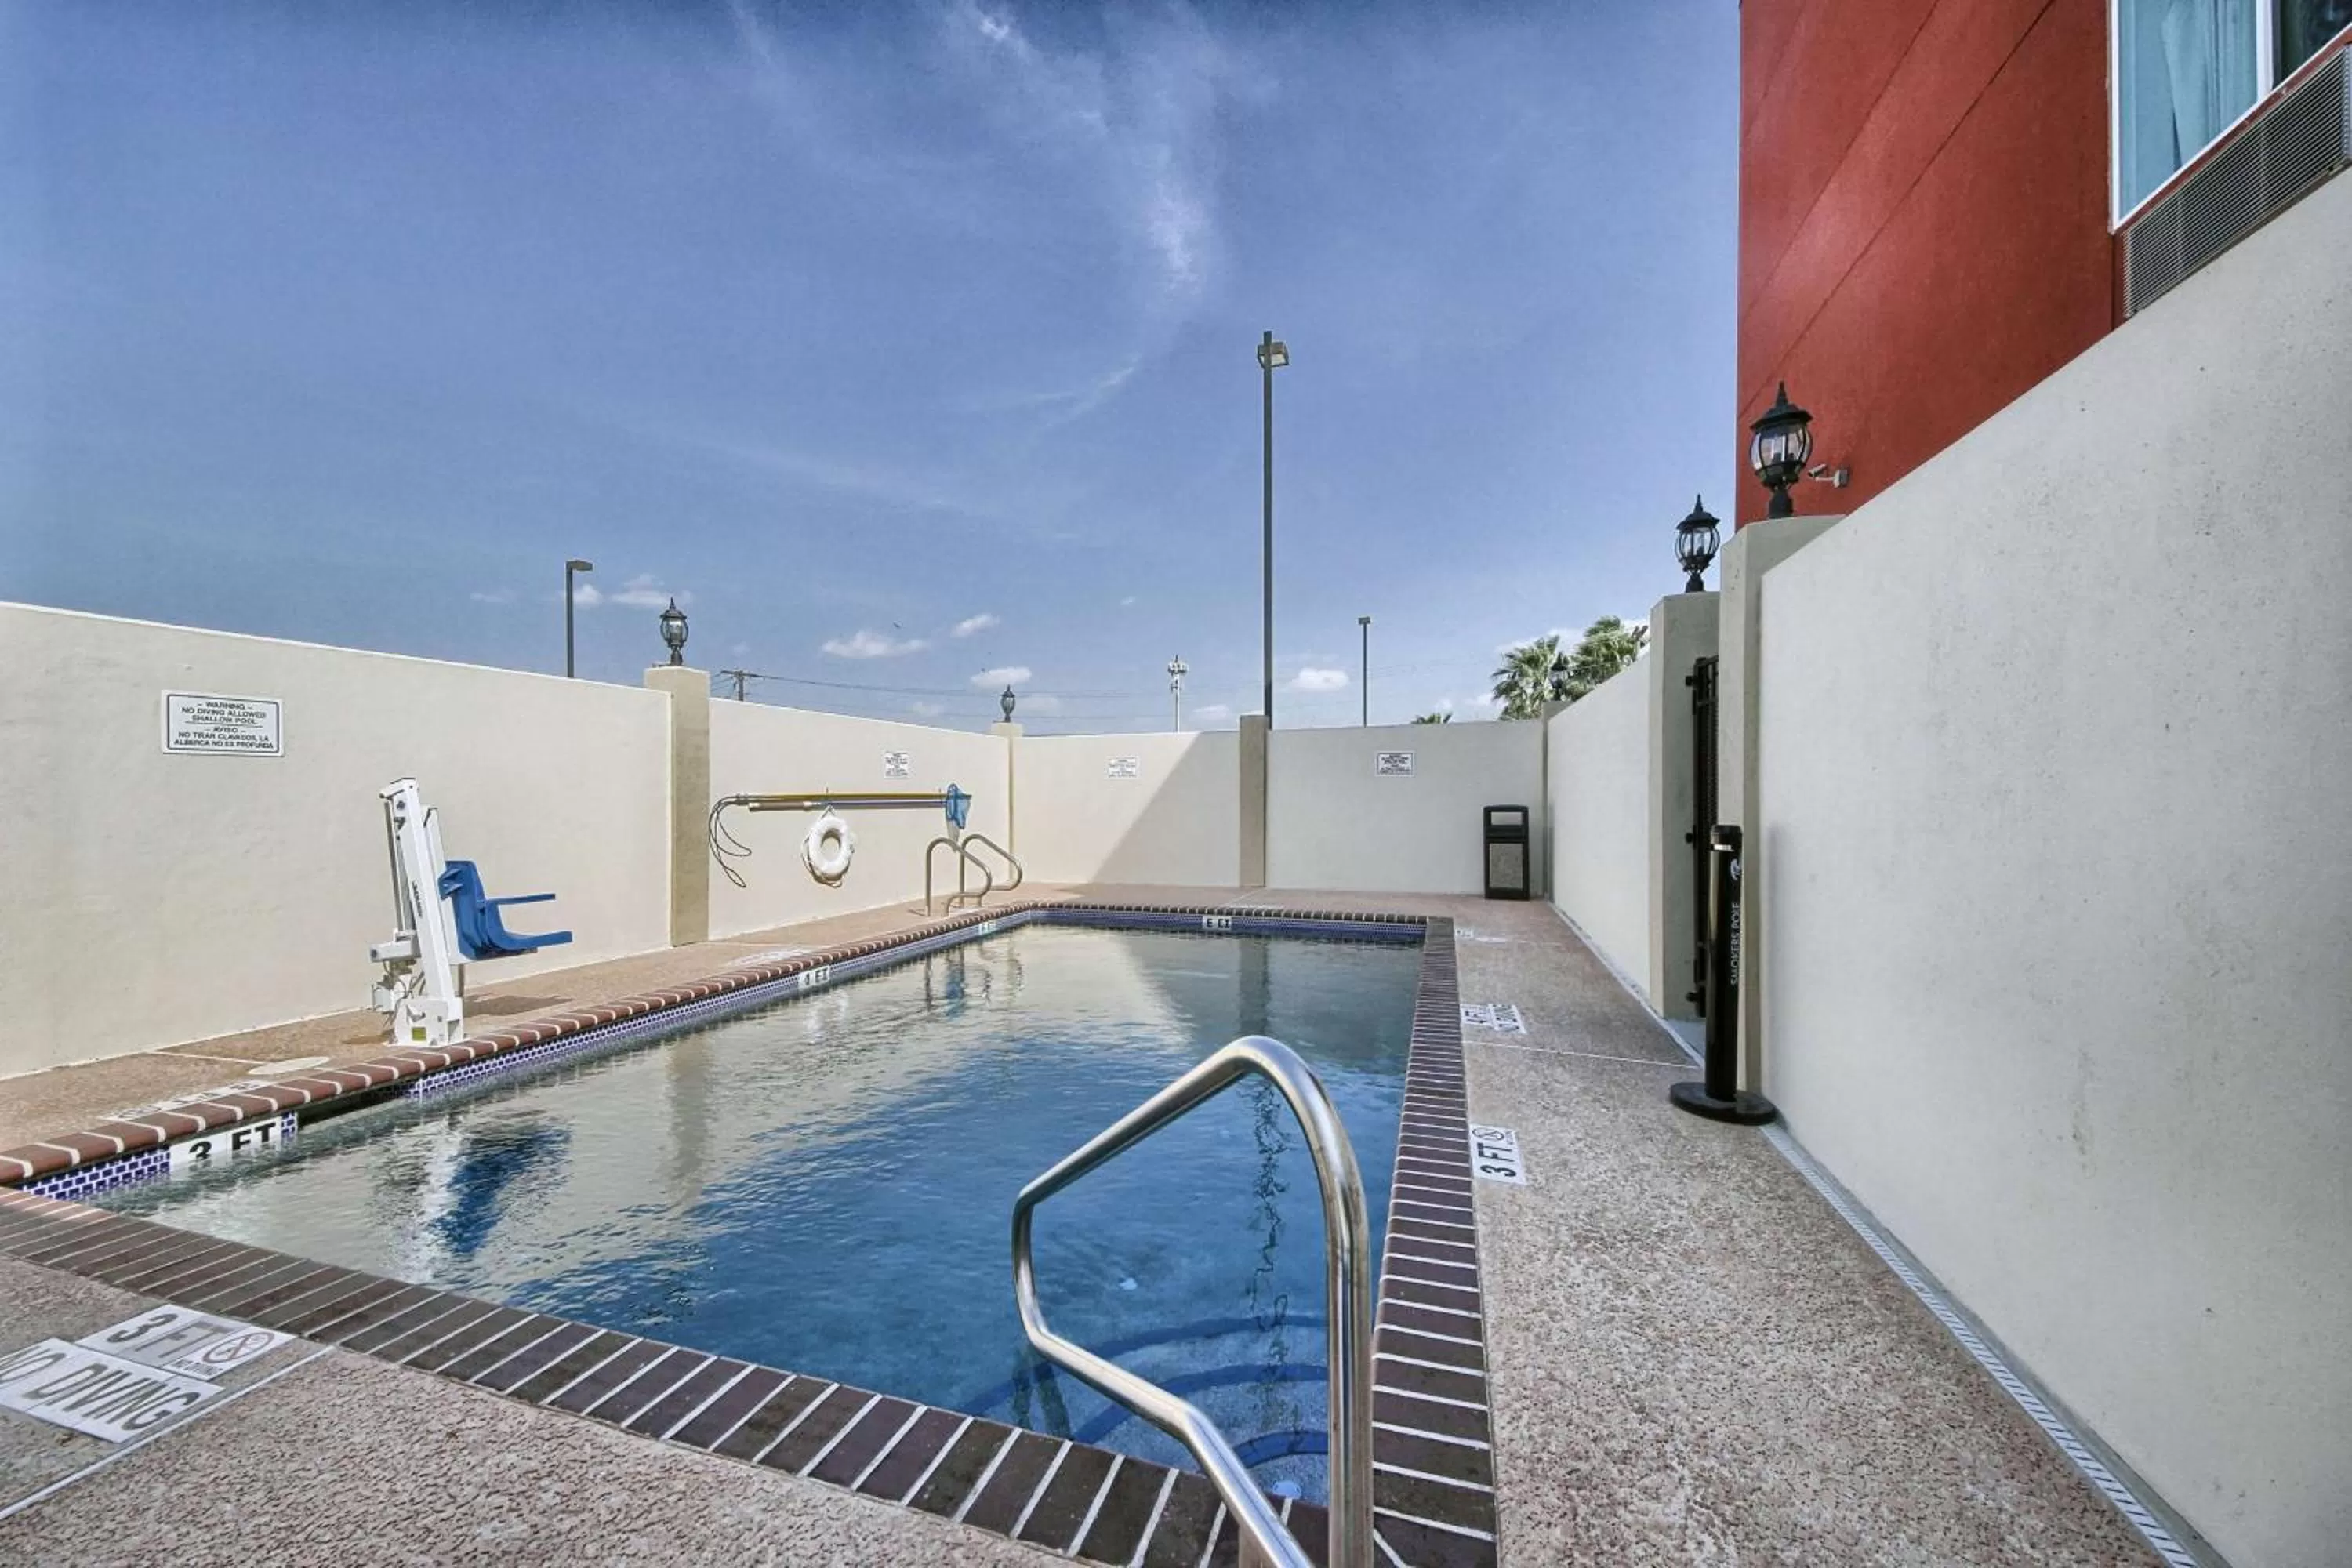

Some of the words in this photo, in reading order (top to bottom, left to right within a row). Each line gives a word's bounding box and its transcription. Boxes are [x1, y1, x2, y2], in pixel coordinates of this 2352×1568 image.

[192, 714, 233, 723] SHALLOW
[227, 710, 267, 719] ALLOWED
[231, 1122, 277, 1152] FT
[1476, 1142, 1515, 1163] FT
[1479, 1164, 1517, 1178] 3
[107, 1312, 179, 1344] 3
[134, 1320, 237, 1359] FT
[21, 1362, 201, 1432] DIVING
